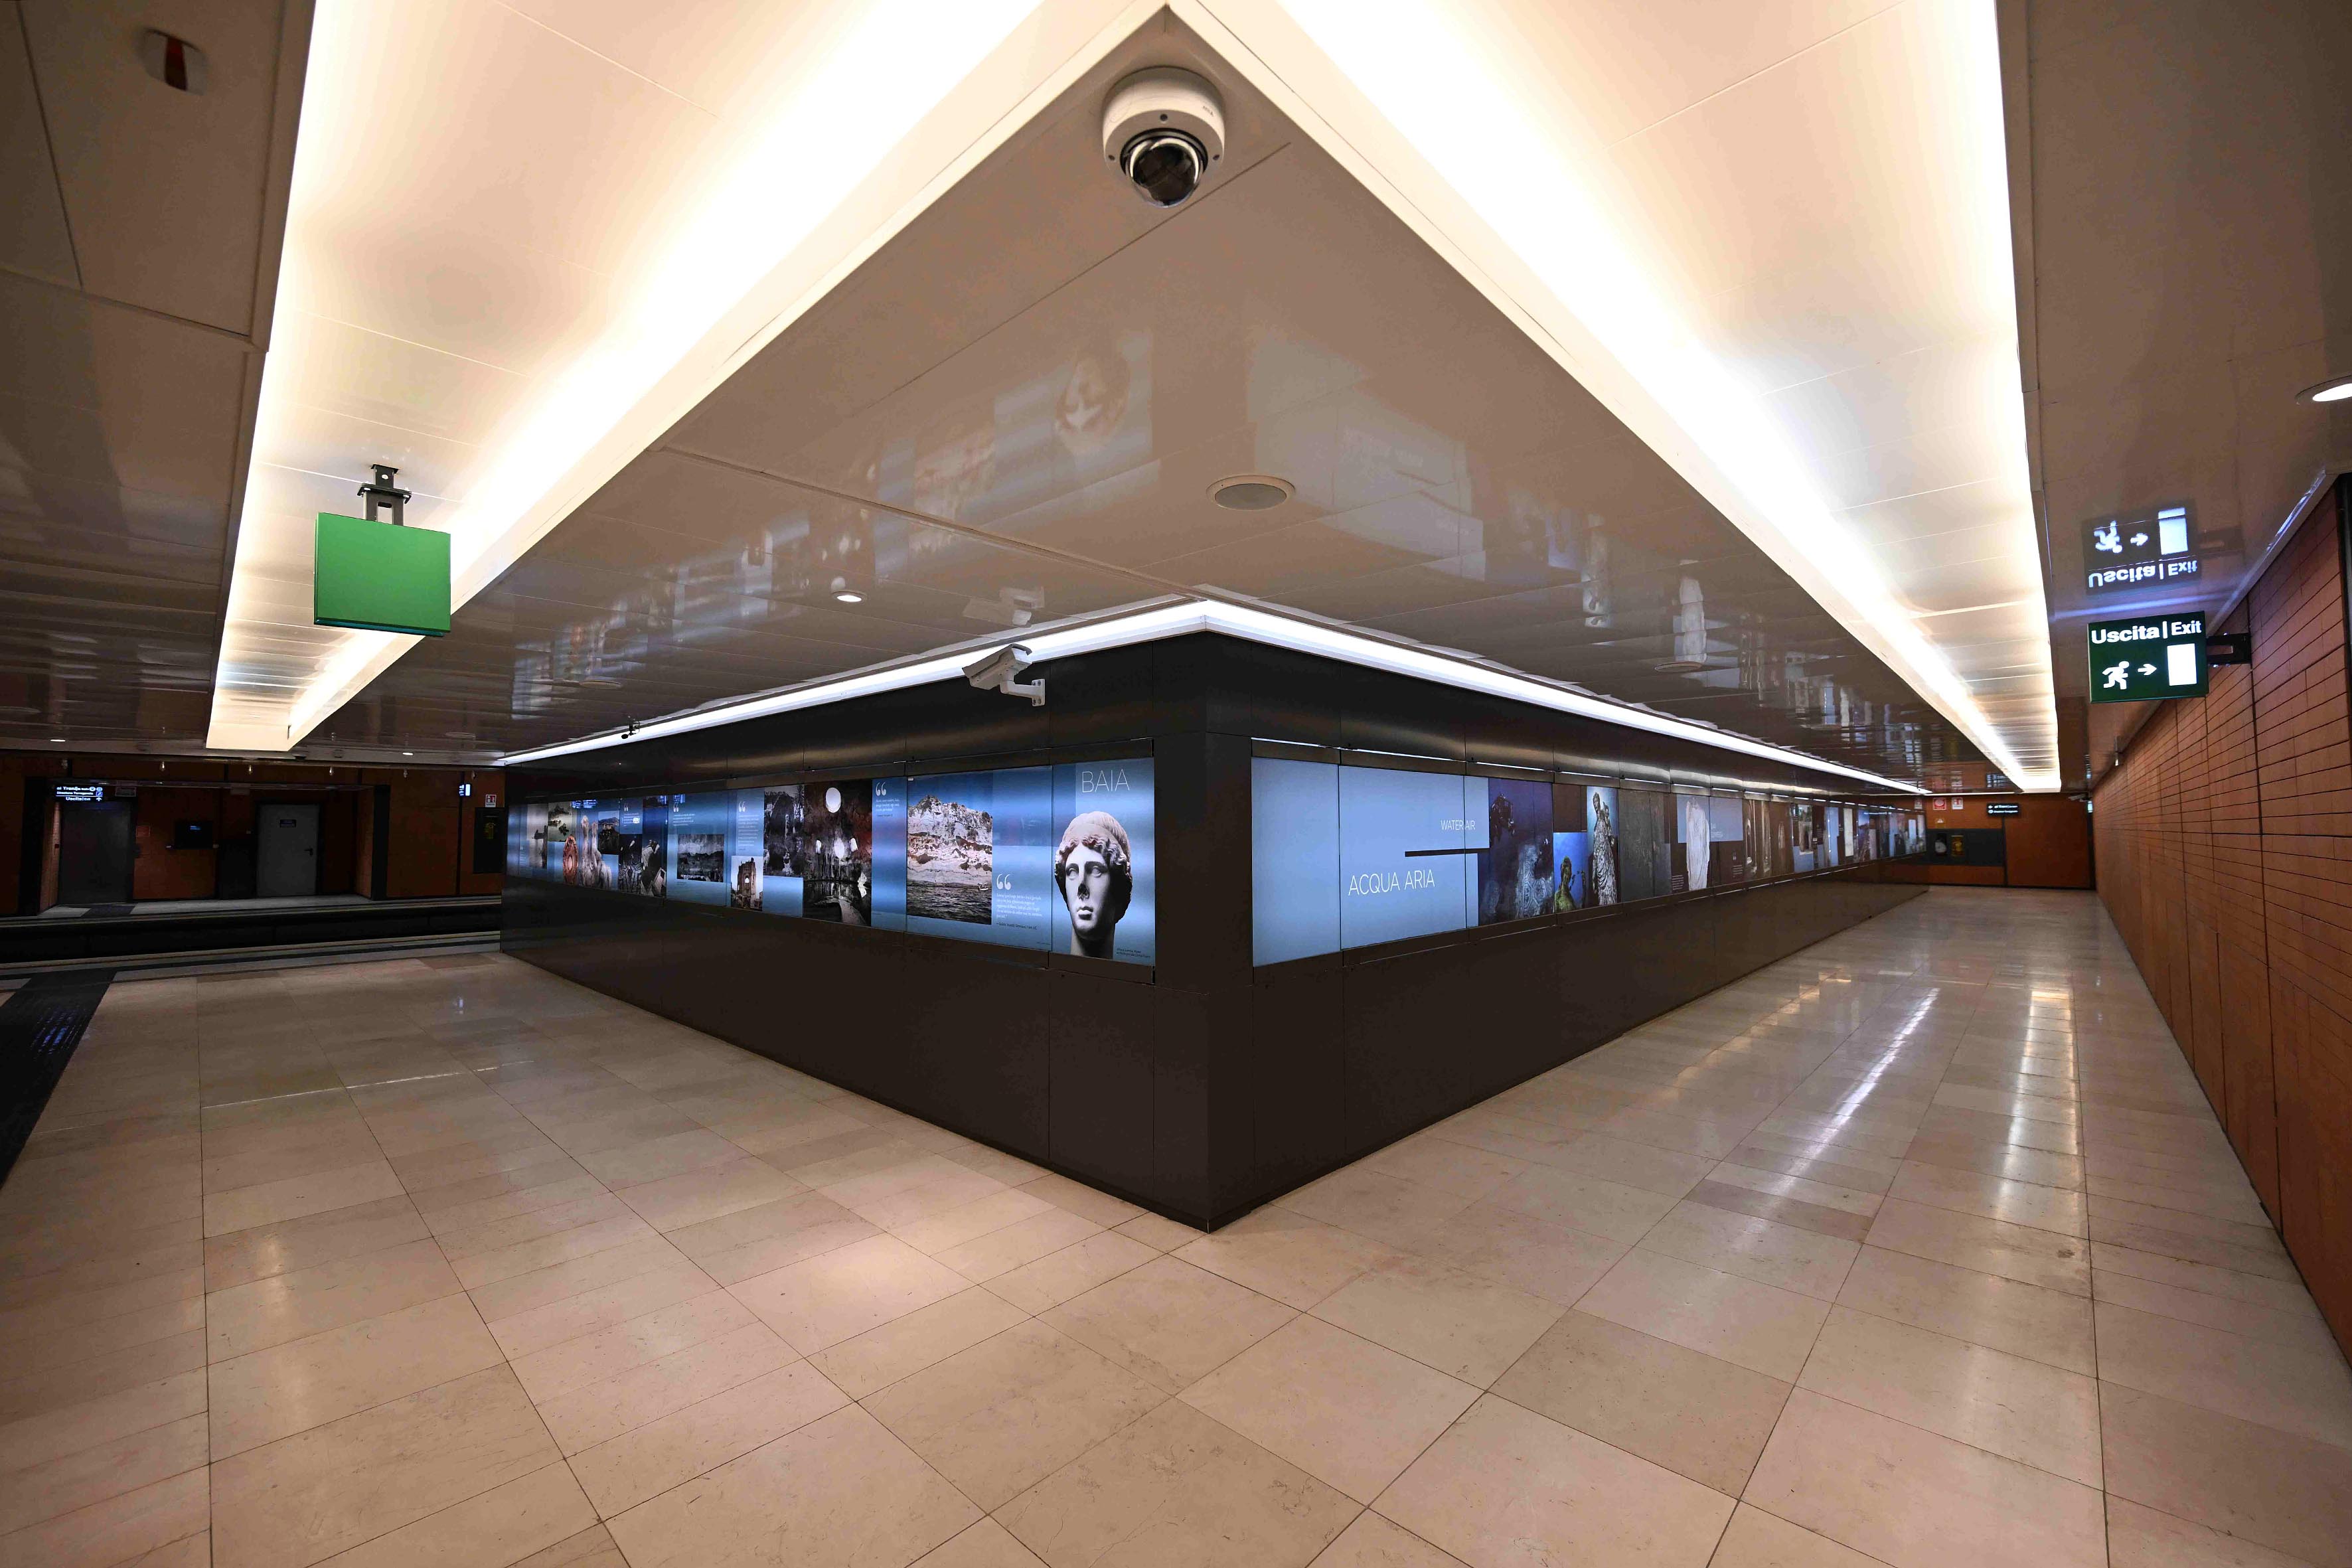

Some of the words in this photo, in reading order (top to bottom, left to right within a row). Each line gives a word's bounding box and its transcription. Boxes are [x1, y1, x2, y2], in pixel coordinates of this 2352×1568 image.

[2091, 625, 2159, 644] Uscita
[2171, 621, 2202, 635] Exit
[1082, 769, 1130, 793] BAIA
[1441, 820, 1464, 830] WATER
[1465, 820, 1476, 830] AIR
[1348, 872, 1400, 896] ACQUA
[1404, 869, 1435, 890] ARIA
